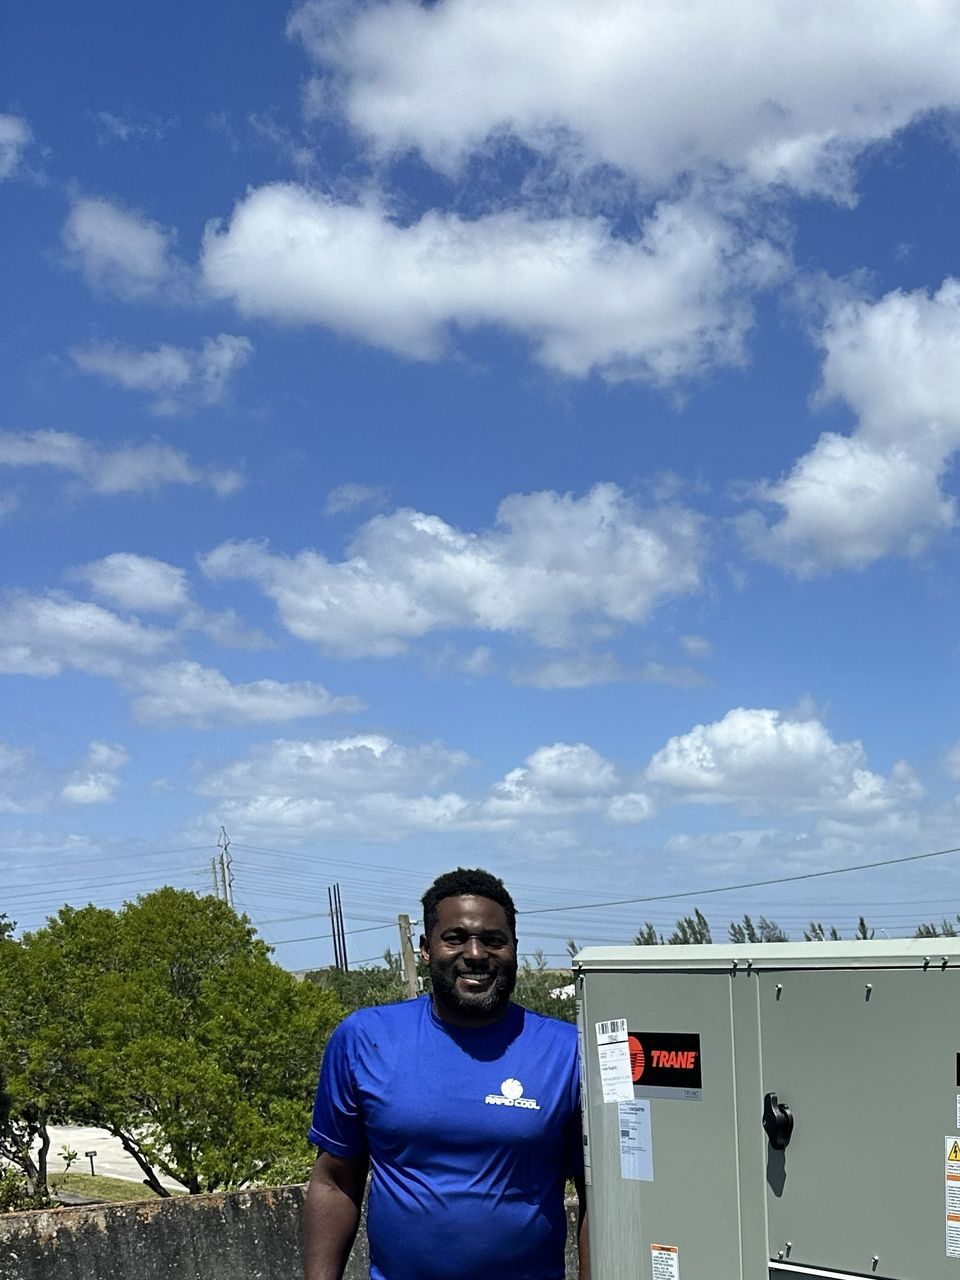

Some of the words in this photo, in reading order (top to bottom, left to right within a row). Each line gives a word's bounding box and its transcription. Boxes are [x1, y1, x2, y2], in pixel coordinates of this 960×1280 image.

[651, 1051, 695, 1068] TRANE
[485, 1096, 514, 1106] RAPID
[514, 1099, 541, 1110] COOL
